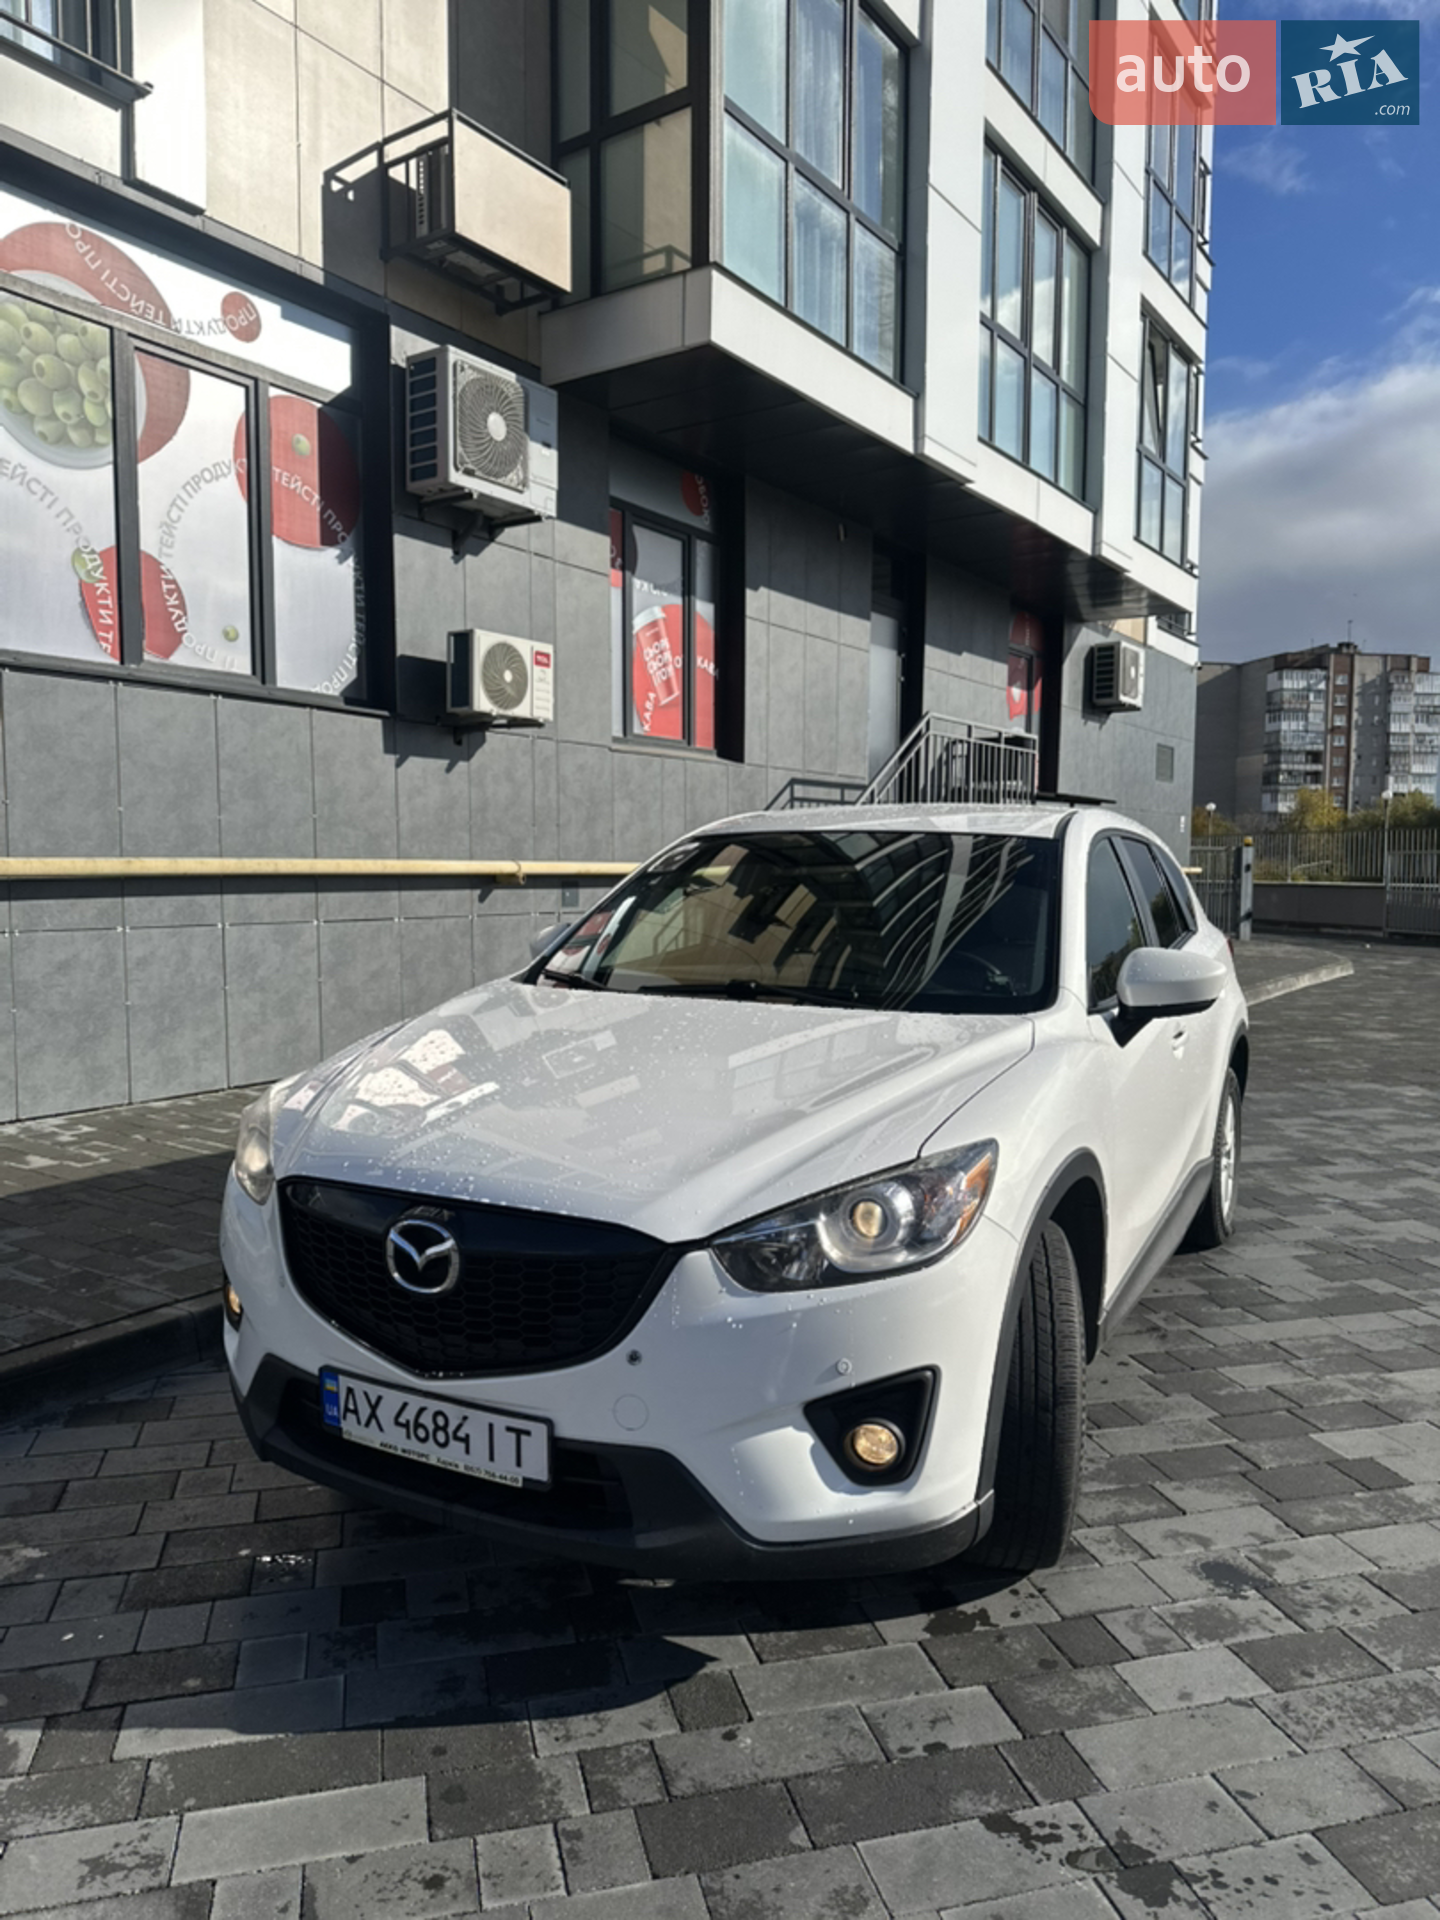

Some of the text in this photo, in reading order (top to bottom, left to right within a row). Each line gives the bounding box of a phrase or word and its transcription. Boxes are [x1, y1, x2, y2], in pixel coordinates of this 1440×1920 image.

[101, 267, 167, 327] ТЕЙСТІ
[158, 493, 190, 559] ТЕЙСТІ
[55, 507, 114, 627] ПРОДУКТИ
[342, 1386, 532, 1468] AX 4684 IT
